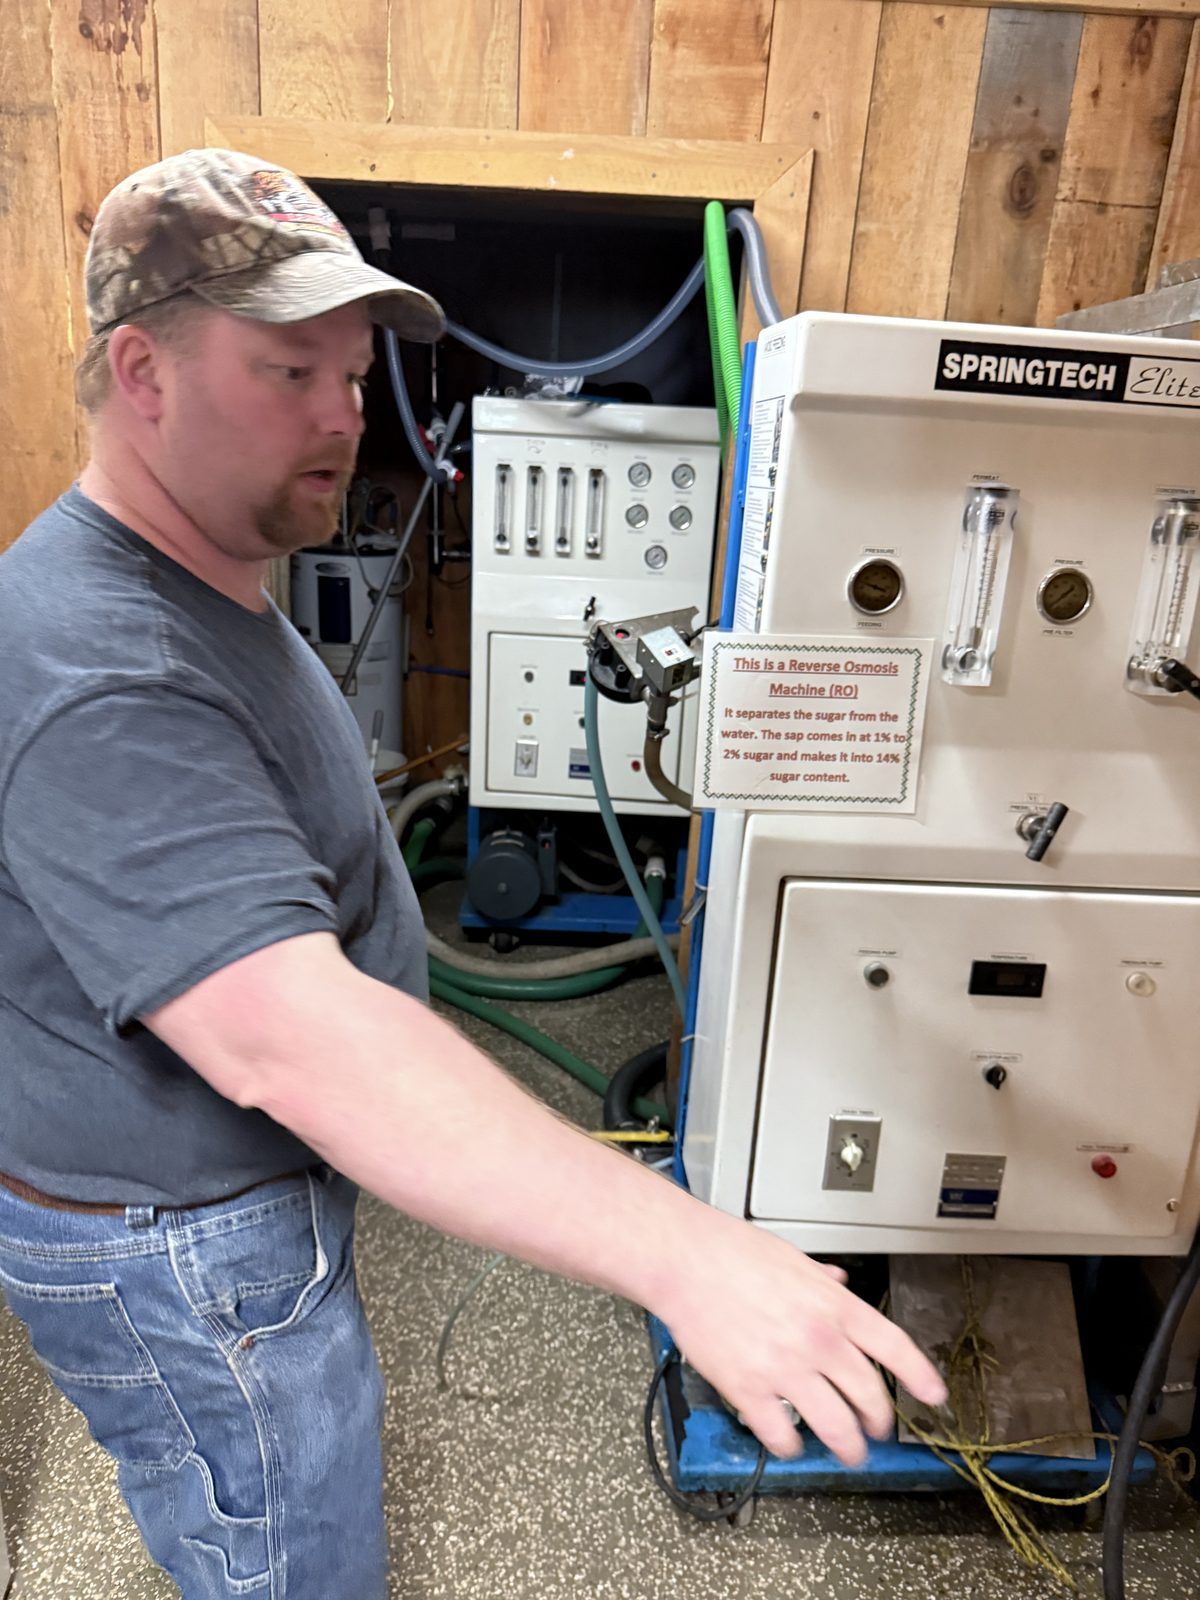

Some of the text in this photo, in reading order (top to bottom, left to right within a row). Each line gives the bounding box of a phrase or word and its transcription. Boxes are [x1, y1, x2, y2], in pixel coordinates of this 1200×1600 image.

[942, 352, 1200, 399] SPRINGTECH Elite
[734, 658, 898, 674] This is a Reverse Osmosis
[769, 683, 858, 698] Machine (RO)
[724, 708, 898, 722] It separates the sugar from the
[721, 730, 905, 743] water. The sap comes in at 1% to
[723, 749, 900, 763] 2% sugar and makes it into 14%
[769, 772, 850, 783] sugar content.
